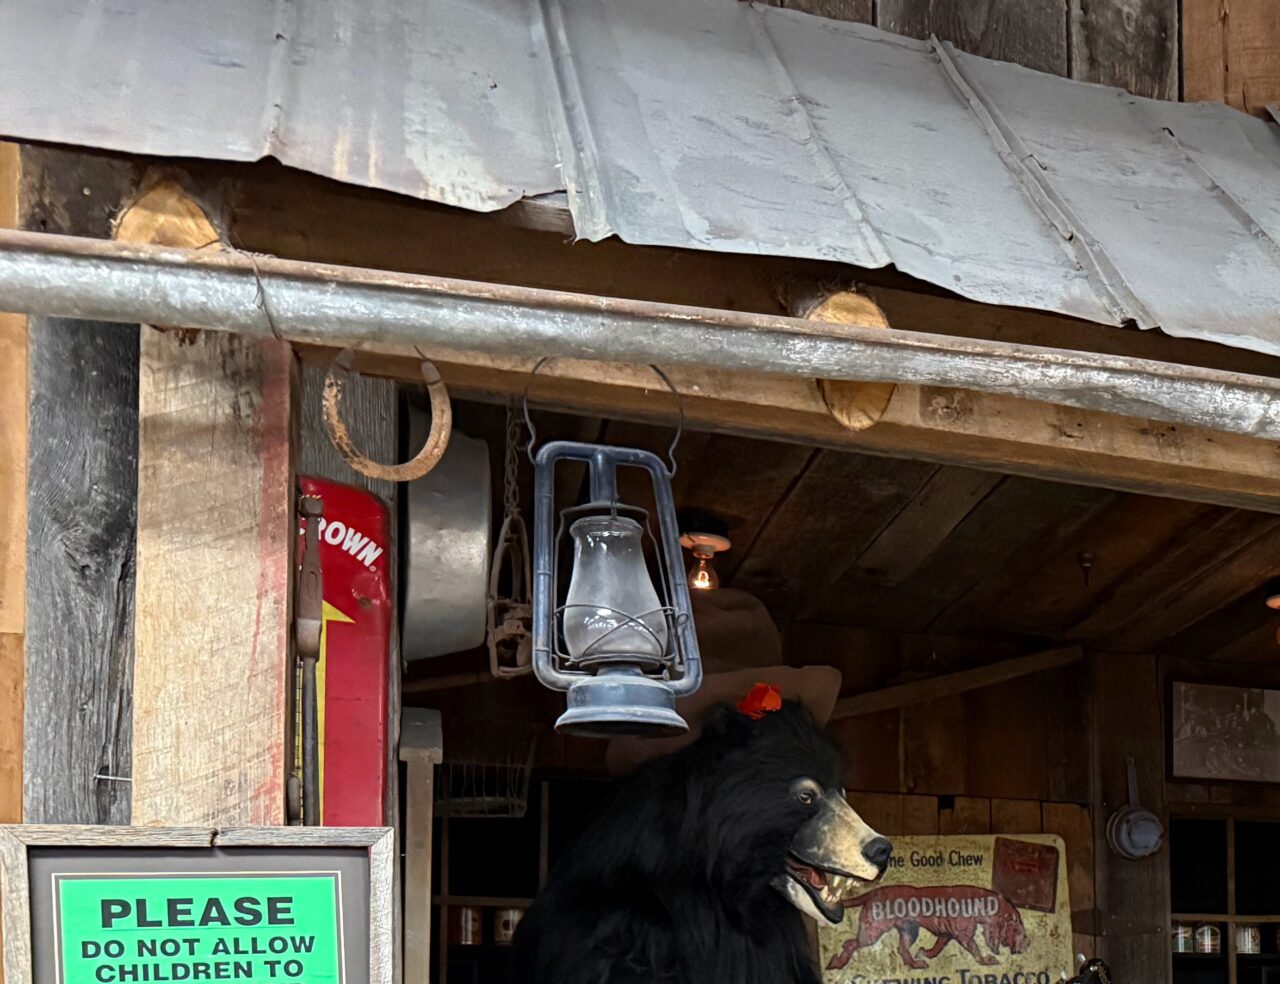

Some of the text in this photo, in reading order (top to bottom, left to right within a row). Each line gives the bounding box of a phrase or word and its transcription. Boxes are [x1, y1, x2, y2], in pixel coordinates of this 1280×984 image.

[910, 850, 944, 868] Good
[949, 850, 984, 867] Chew
[100, 896, 295, 929] PLEASE
[871, 896, 999, 921] BLOODHOUND
[81, 935, 316, 959] DO NOT ALLOW
[95, 959, 304, 983] CHILDREN TO
